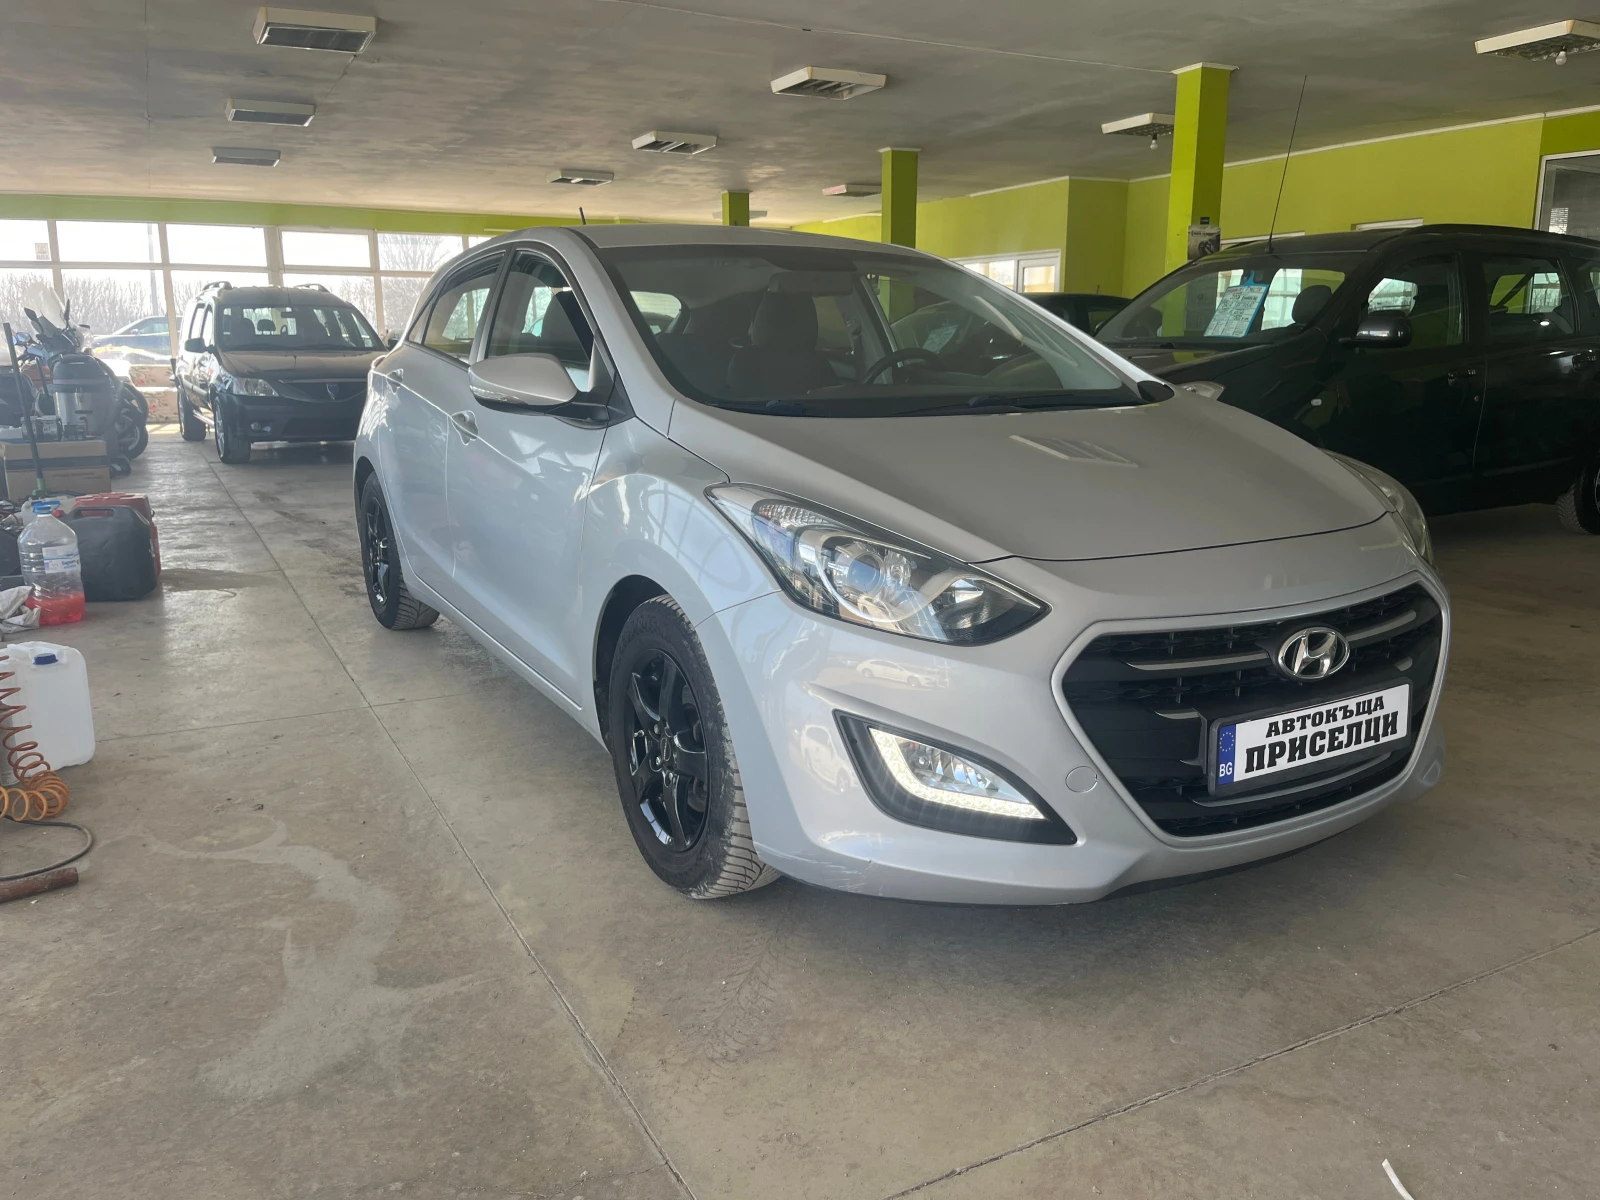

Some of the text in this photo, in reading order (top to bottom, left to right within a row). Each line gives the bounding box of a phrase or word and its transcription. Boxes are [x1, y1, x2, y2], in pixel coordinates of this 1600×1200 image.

[1265, 696, 1385, 738] АВТОКЪЩА
[1244, 711, 1399, 774] ПРИСЕЛЦИ
[1219, 762, 1233, 777] BG
